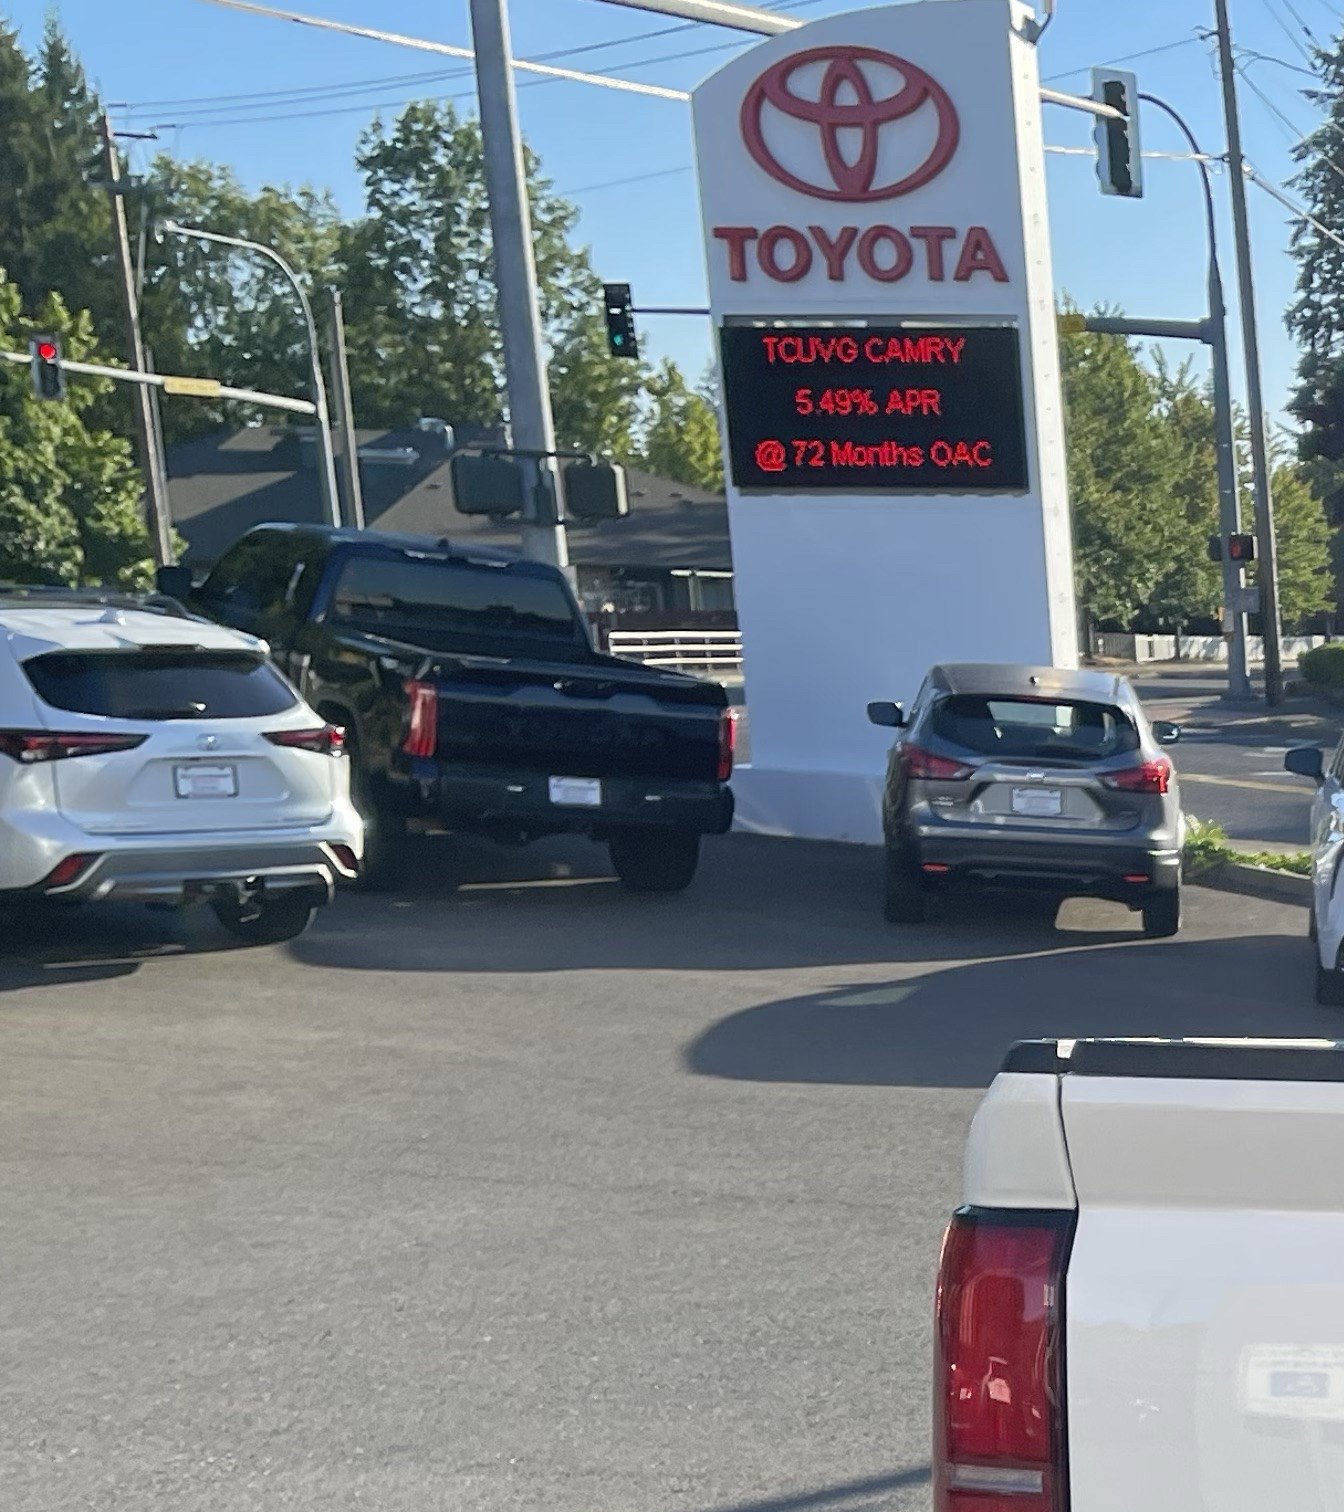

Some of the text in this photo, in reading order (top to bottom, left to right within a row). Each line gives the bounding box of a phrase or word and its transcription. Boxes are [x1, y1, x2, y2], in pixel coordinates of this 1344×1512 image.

[714, 224, 1010, 283] TOYOTA
[864, 336, 966, 365] CAMRY
[795, 386, 942, 416] 5.49% APR
[755, 440, 993, 472] @ 72 Months OAC
